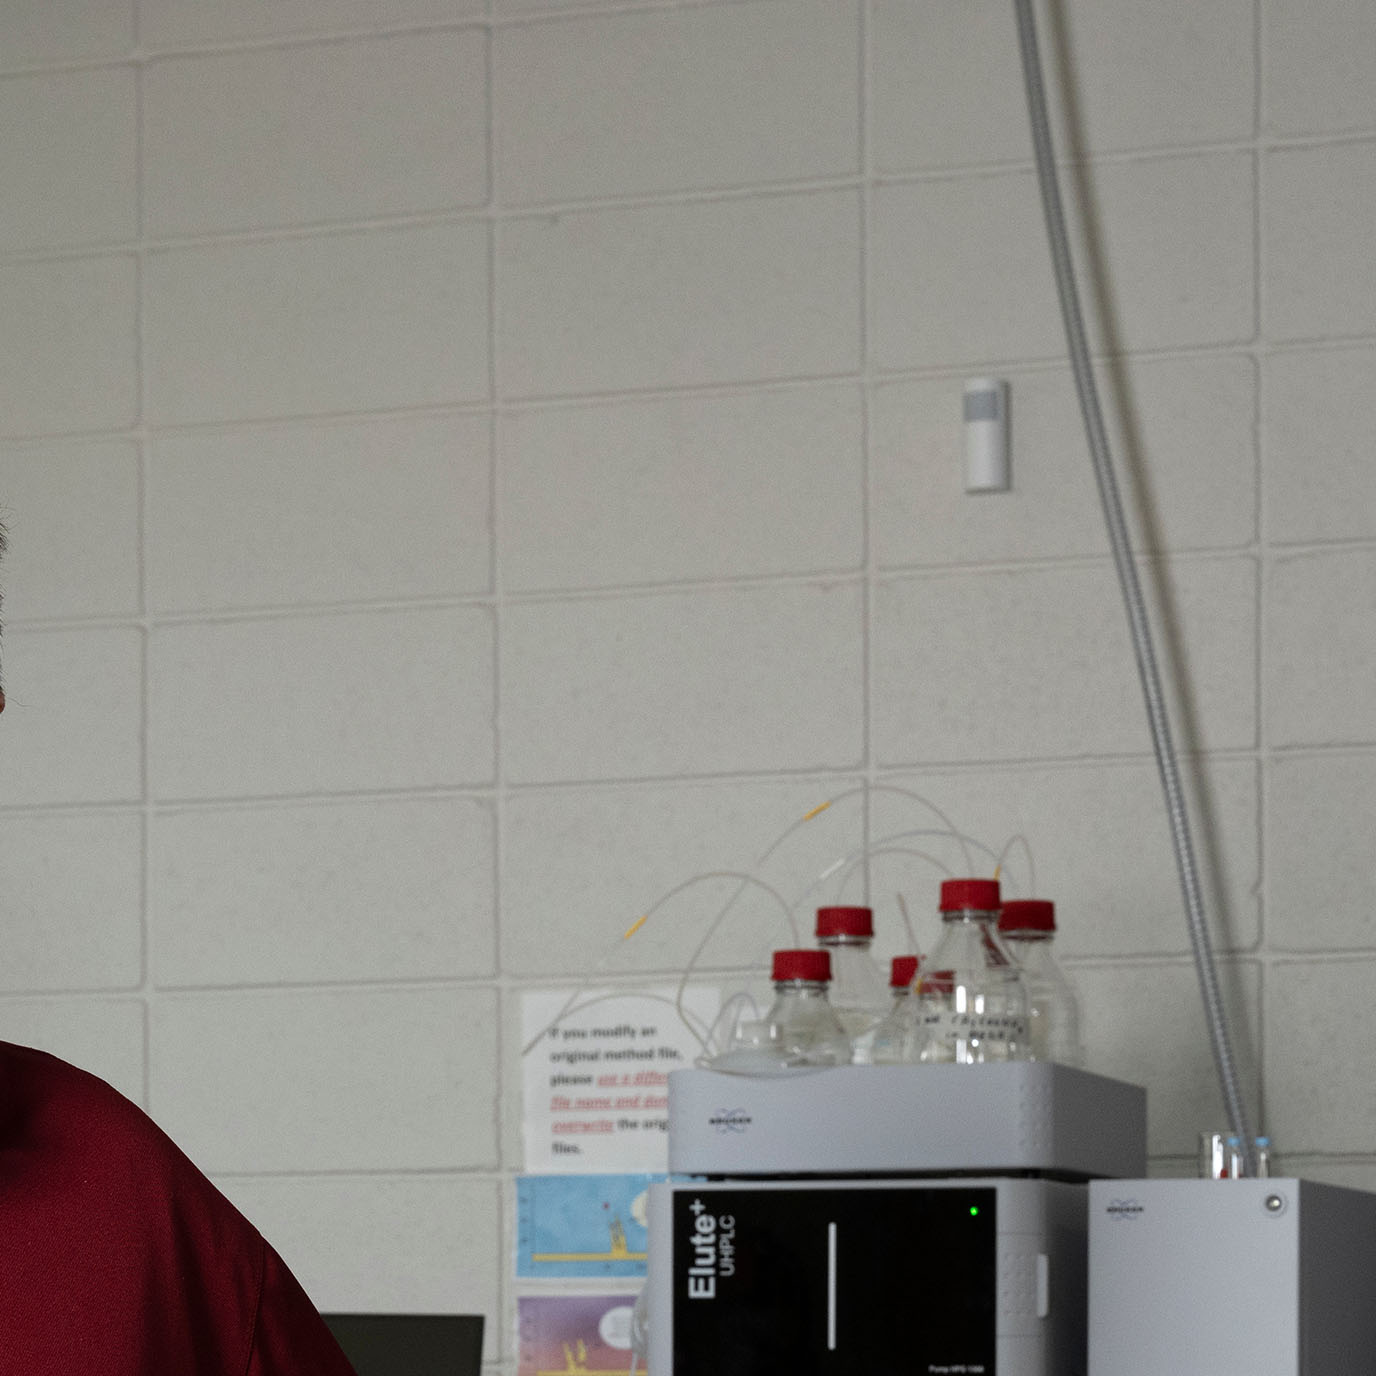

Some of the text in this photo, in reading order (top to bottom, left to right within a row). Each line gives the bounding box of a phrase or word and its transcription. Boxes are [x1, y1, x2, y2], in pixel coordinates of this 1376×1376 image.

[549, 1025, 657, 1040] If you modify an
[550, 1049, 601, 1064] original
[605, 1048, 655, 1060] method
[550, 1074, 593, 1087] please
[575, 1098, 611, 1109] name
[551, 1118, 670, 1134] overwrite the orig
[552, 1142, 582, 1155] files.
[719, 1215, 736, 1277] UHPLC
